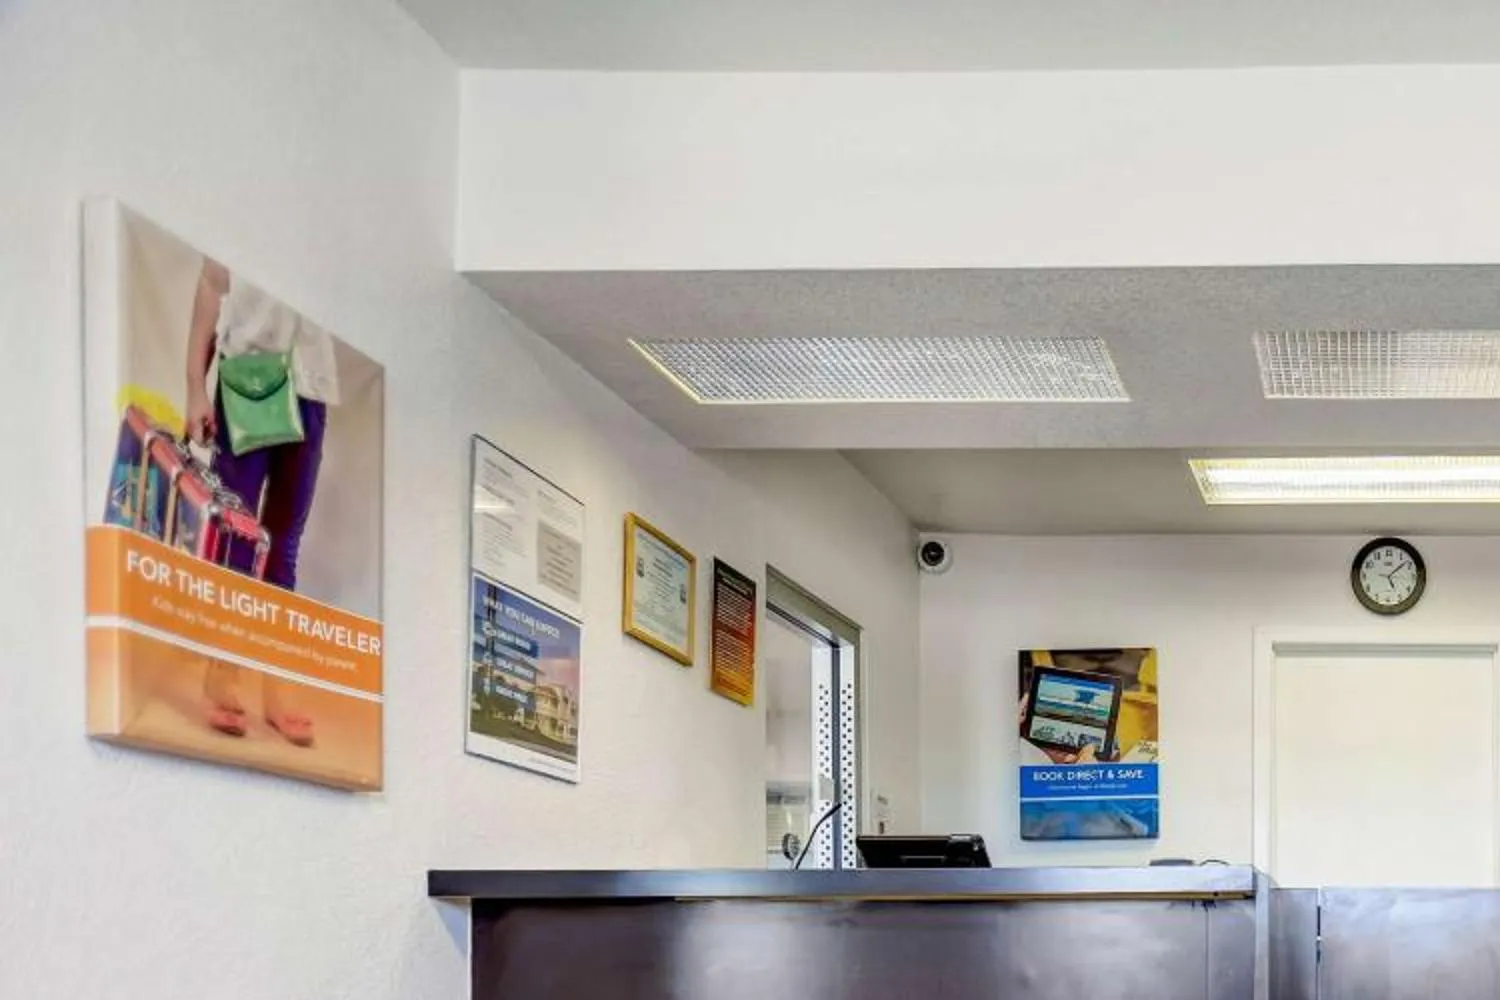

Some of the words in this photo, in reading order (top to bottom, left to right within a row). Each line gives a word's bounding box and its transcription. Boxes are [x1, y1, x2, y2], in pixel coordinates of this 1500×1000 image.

[127, 549, 171, 587] FOR
[175, 567, 215, 604] THE
[220, 584, 280, 625] LIGHT
[285, 608, 381, 656] TRAVELER
[1033, 771, 1065, 782] BOOK
[1067, 770, 1105, 782] DIRECT
[1107, 769, 1116, 780] &
[1117, 769, 1145, 780] SAVE
